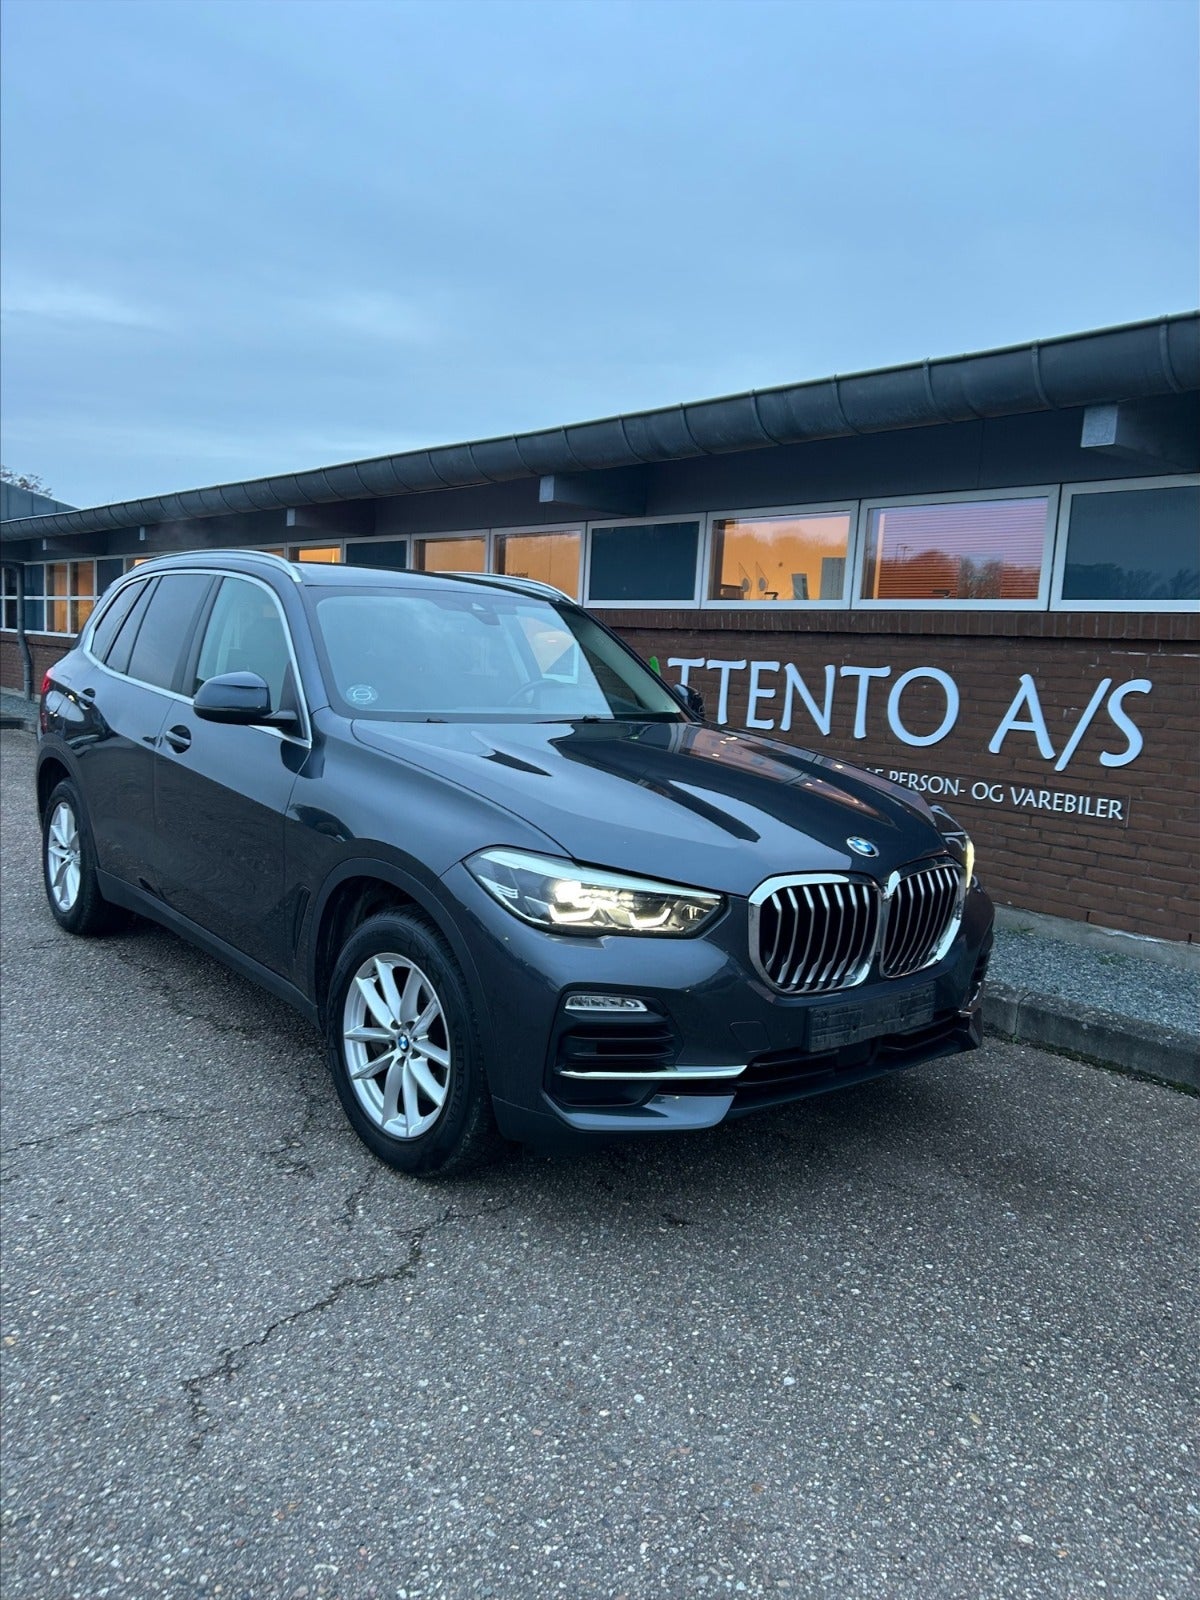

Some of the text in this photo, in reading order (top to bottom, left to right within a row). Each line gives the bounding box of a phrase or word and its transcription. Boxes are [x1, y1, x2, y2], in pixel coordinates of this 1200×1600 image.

[649, 656, 1152, 772] TTENTO A/S
[971, 782, 1004, 803] OG
[1010, 786, 1124, 821] VAREBILER
